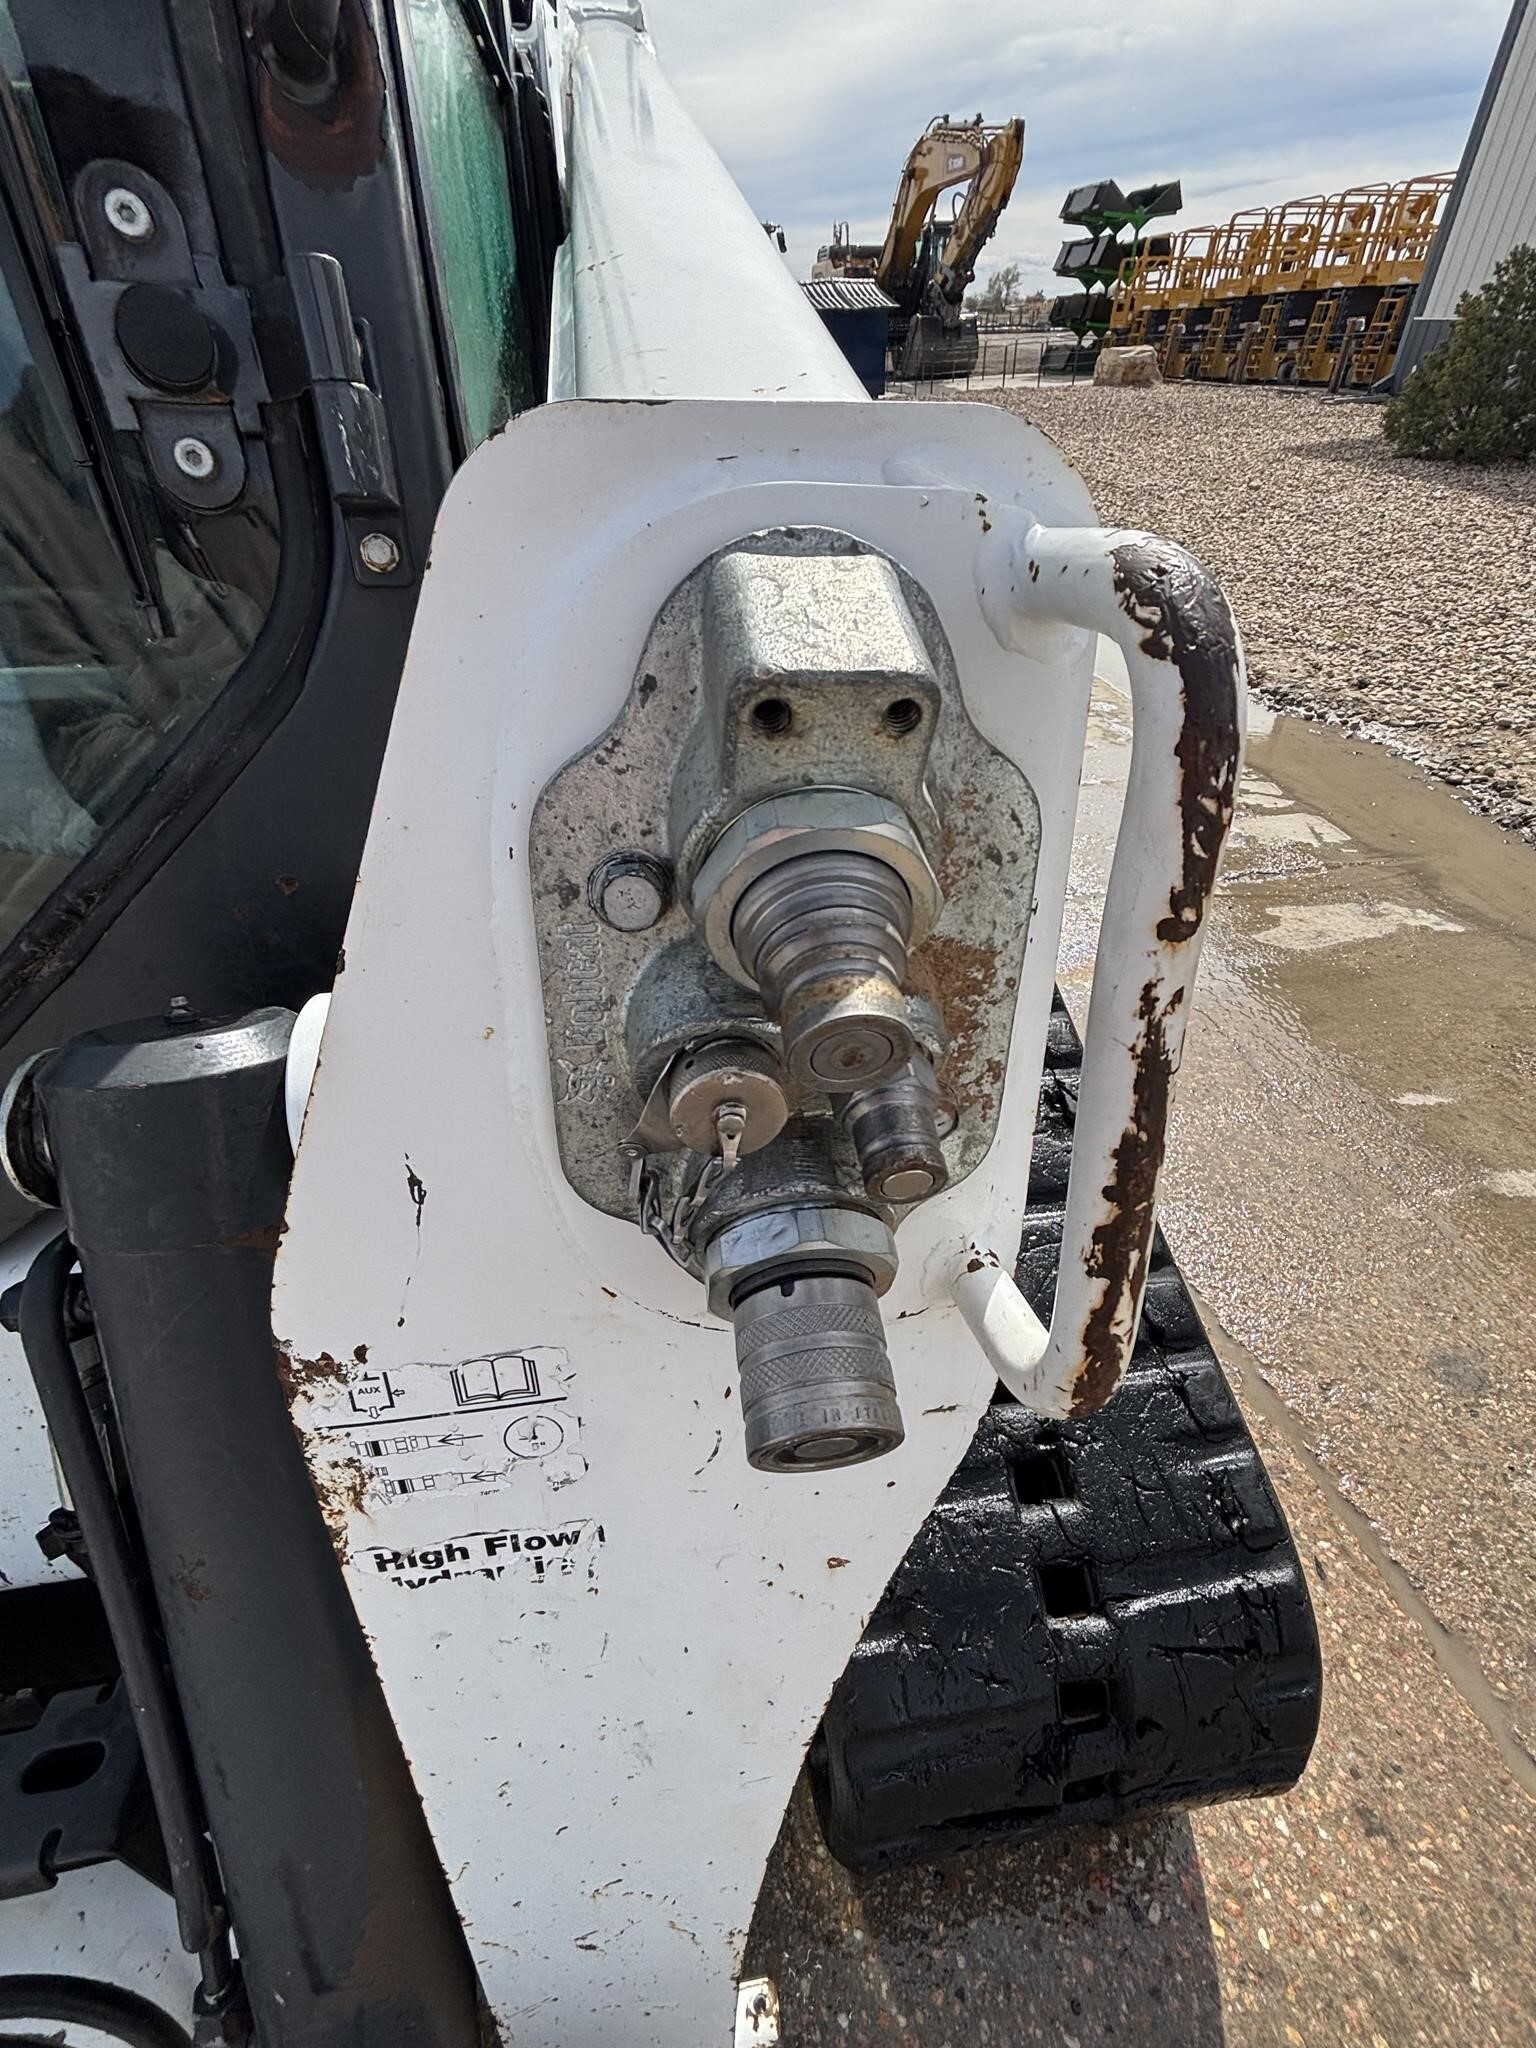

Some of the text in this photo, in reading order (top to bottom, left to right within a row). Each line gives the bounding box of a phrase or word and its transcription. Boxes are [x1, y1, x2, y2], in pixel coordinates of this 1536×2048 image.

[556, 921, 607, 1050] Bobcat
[358, 1386, 381, 1395] AUX
[374, 1530, 581, 1573] High Flow
